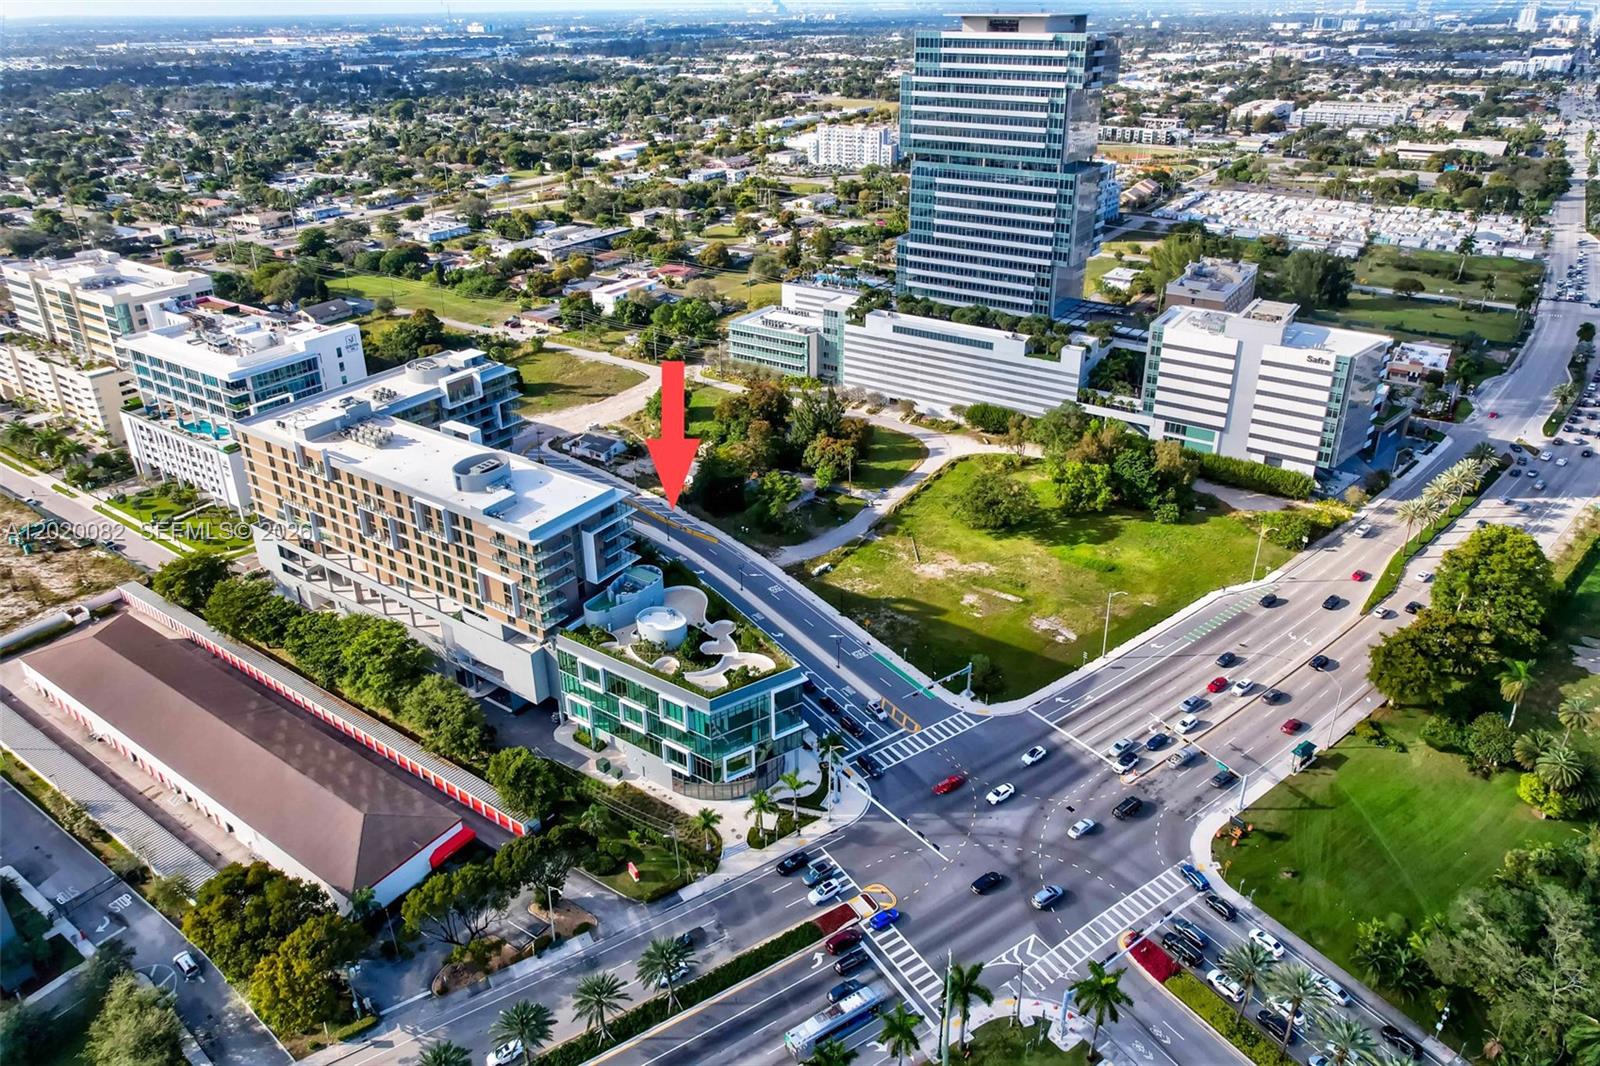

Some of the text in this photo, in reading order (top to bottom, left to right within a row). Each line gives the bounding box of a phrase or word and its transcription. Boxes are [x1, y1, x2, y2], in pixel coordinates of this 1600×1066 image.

[1306, 355, 1330, 366] Safra
[56, 886, 80, 905] STOP
[108, 893, 133, 913] STOP
